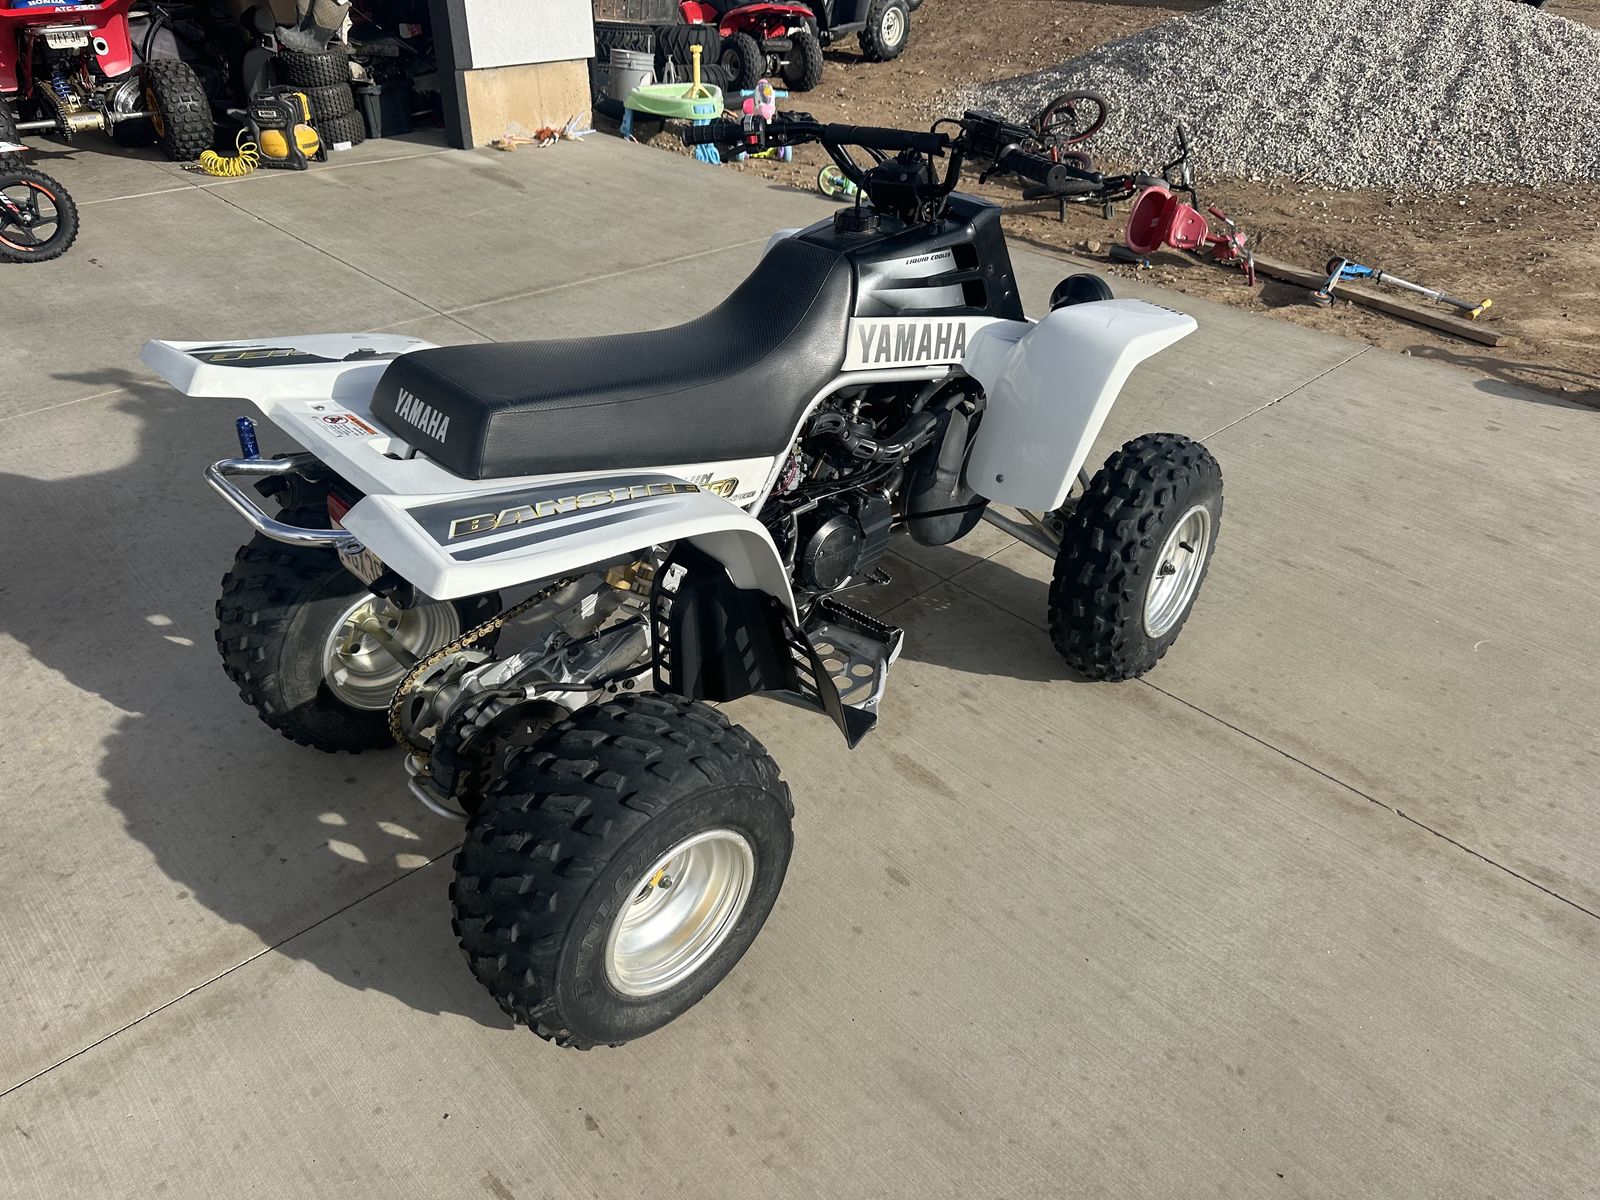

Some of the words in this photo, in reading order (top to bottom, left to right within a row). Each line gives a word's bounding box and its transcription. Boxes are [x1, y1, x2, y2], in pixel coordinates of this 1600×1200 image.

[905, 257, 929, 265] LIQUID
[858, 322, 966, 364] YAMAHA
[394, 387, 451, 444] YAMAHA
[448, 483, 701, 540] BANSHEE
